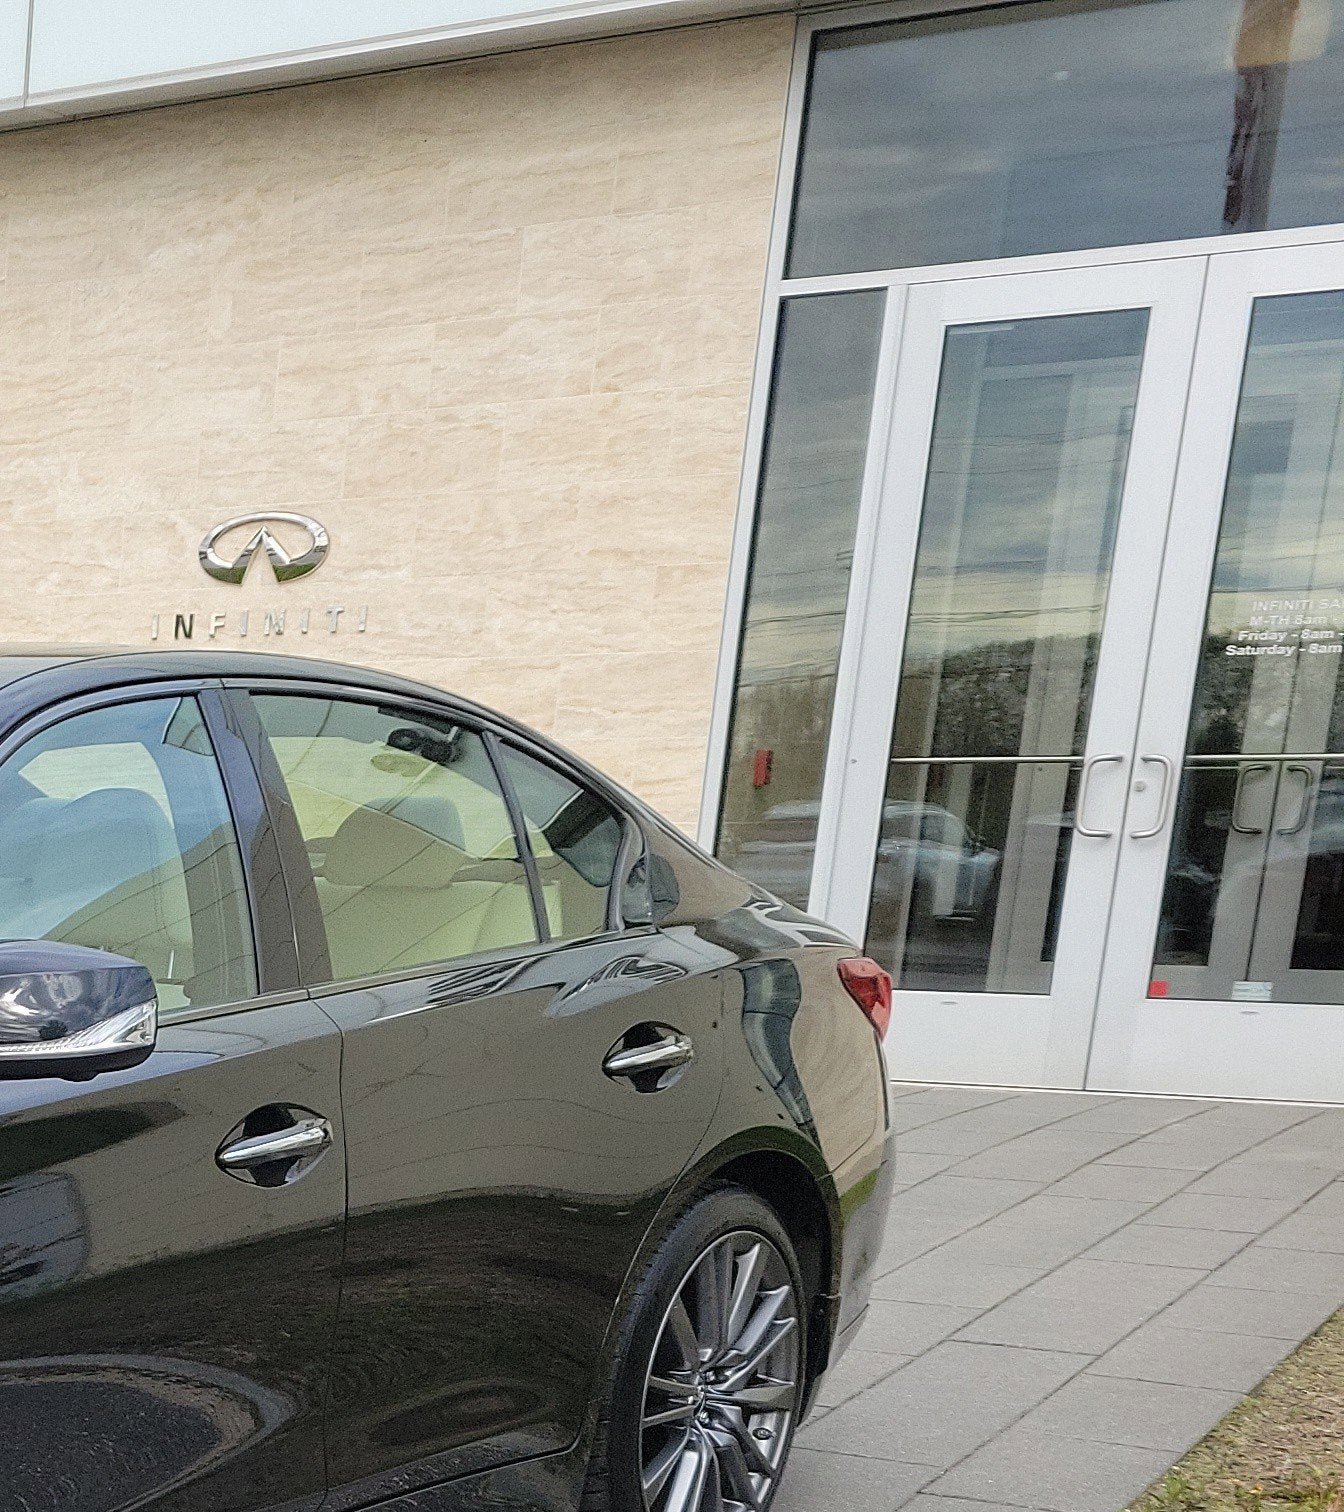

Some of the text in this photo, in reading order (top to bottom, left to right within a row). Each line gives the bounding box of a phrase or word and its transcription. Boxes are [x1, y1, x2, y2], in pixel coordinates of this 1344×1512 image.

[151, 606, 369, 640] INFINITI
[1237, 631, 1288, 642] Friday
[1300, 628, 1334, 639] 8am
[1225, 644, 1297, 656] Saturday
